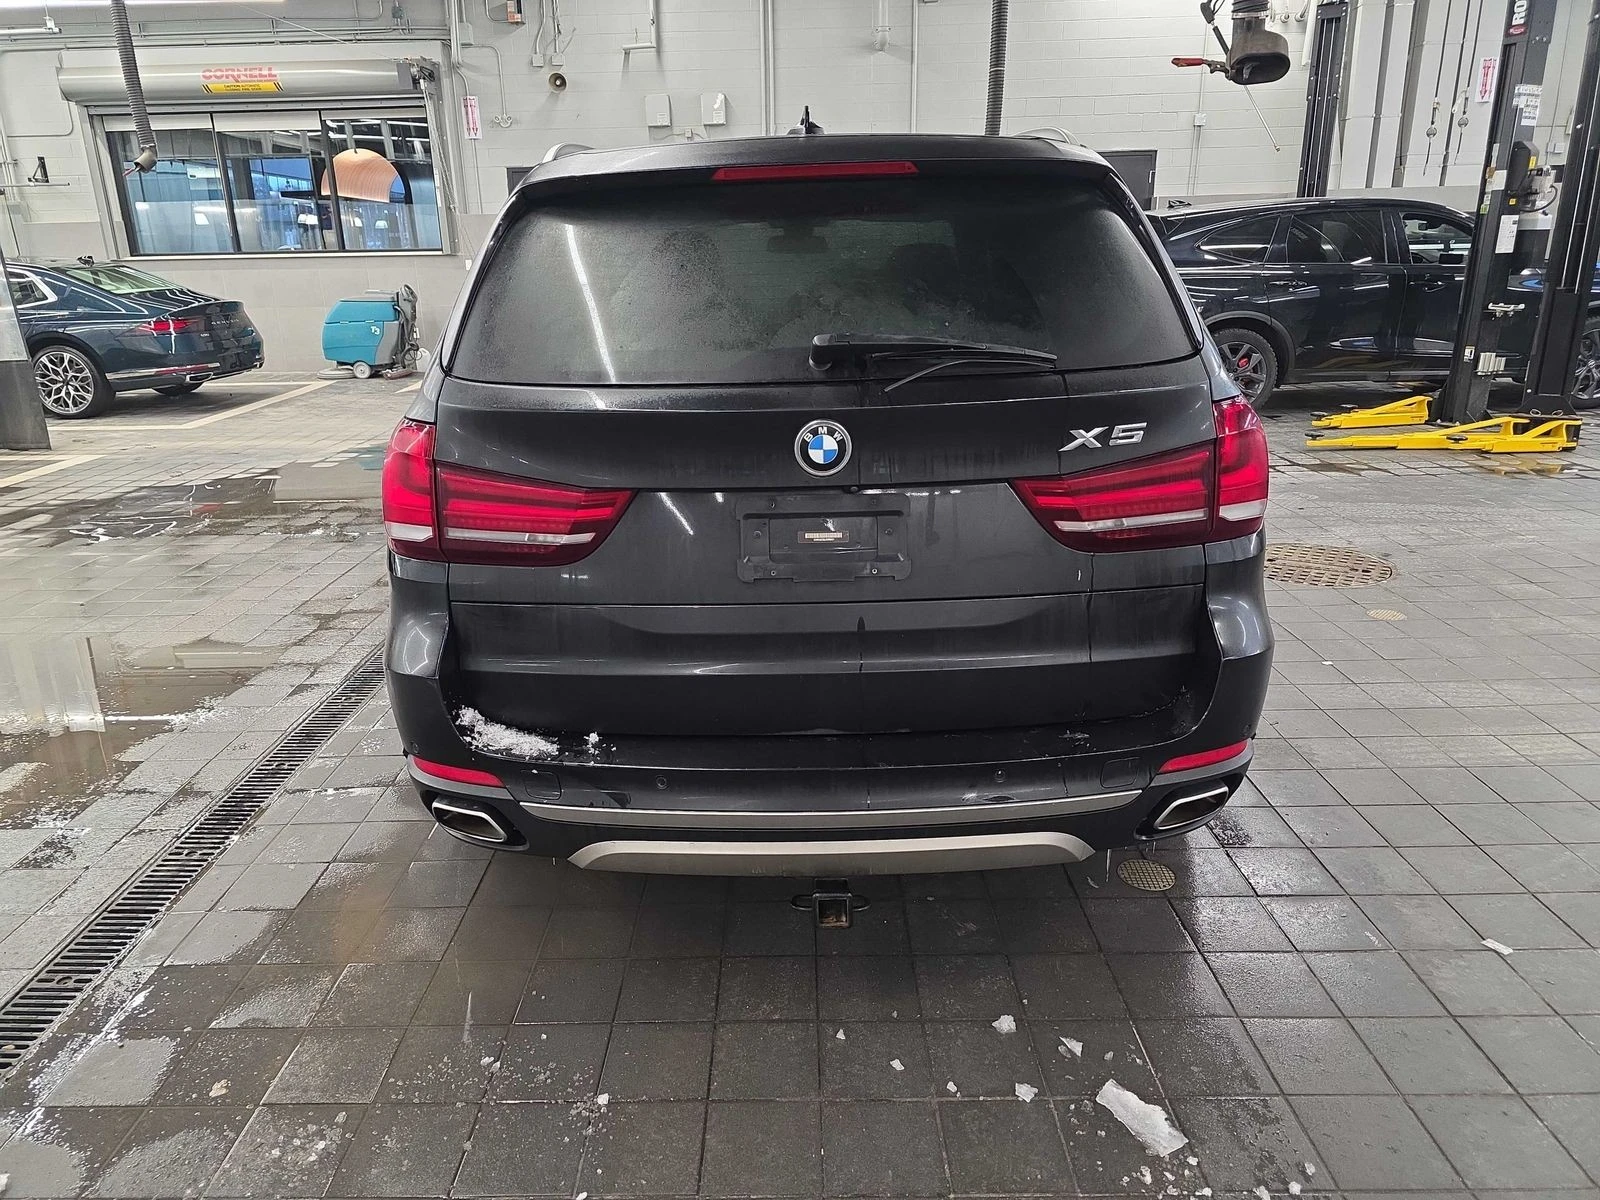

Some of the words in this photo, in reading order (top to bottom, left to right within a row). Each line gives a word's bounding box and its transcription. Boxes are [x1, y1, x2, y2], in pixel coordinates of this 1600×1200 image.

[201, 67, 277, 82] CORNELL
[370, 326, 380, 335] T3
[803, 426, 843, 442] BMW
[1058, 422, 1148, 452] X5
